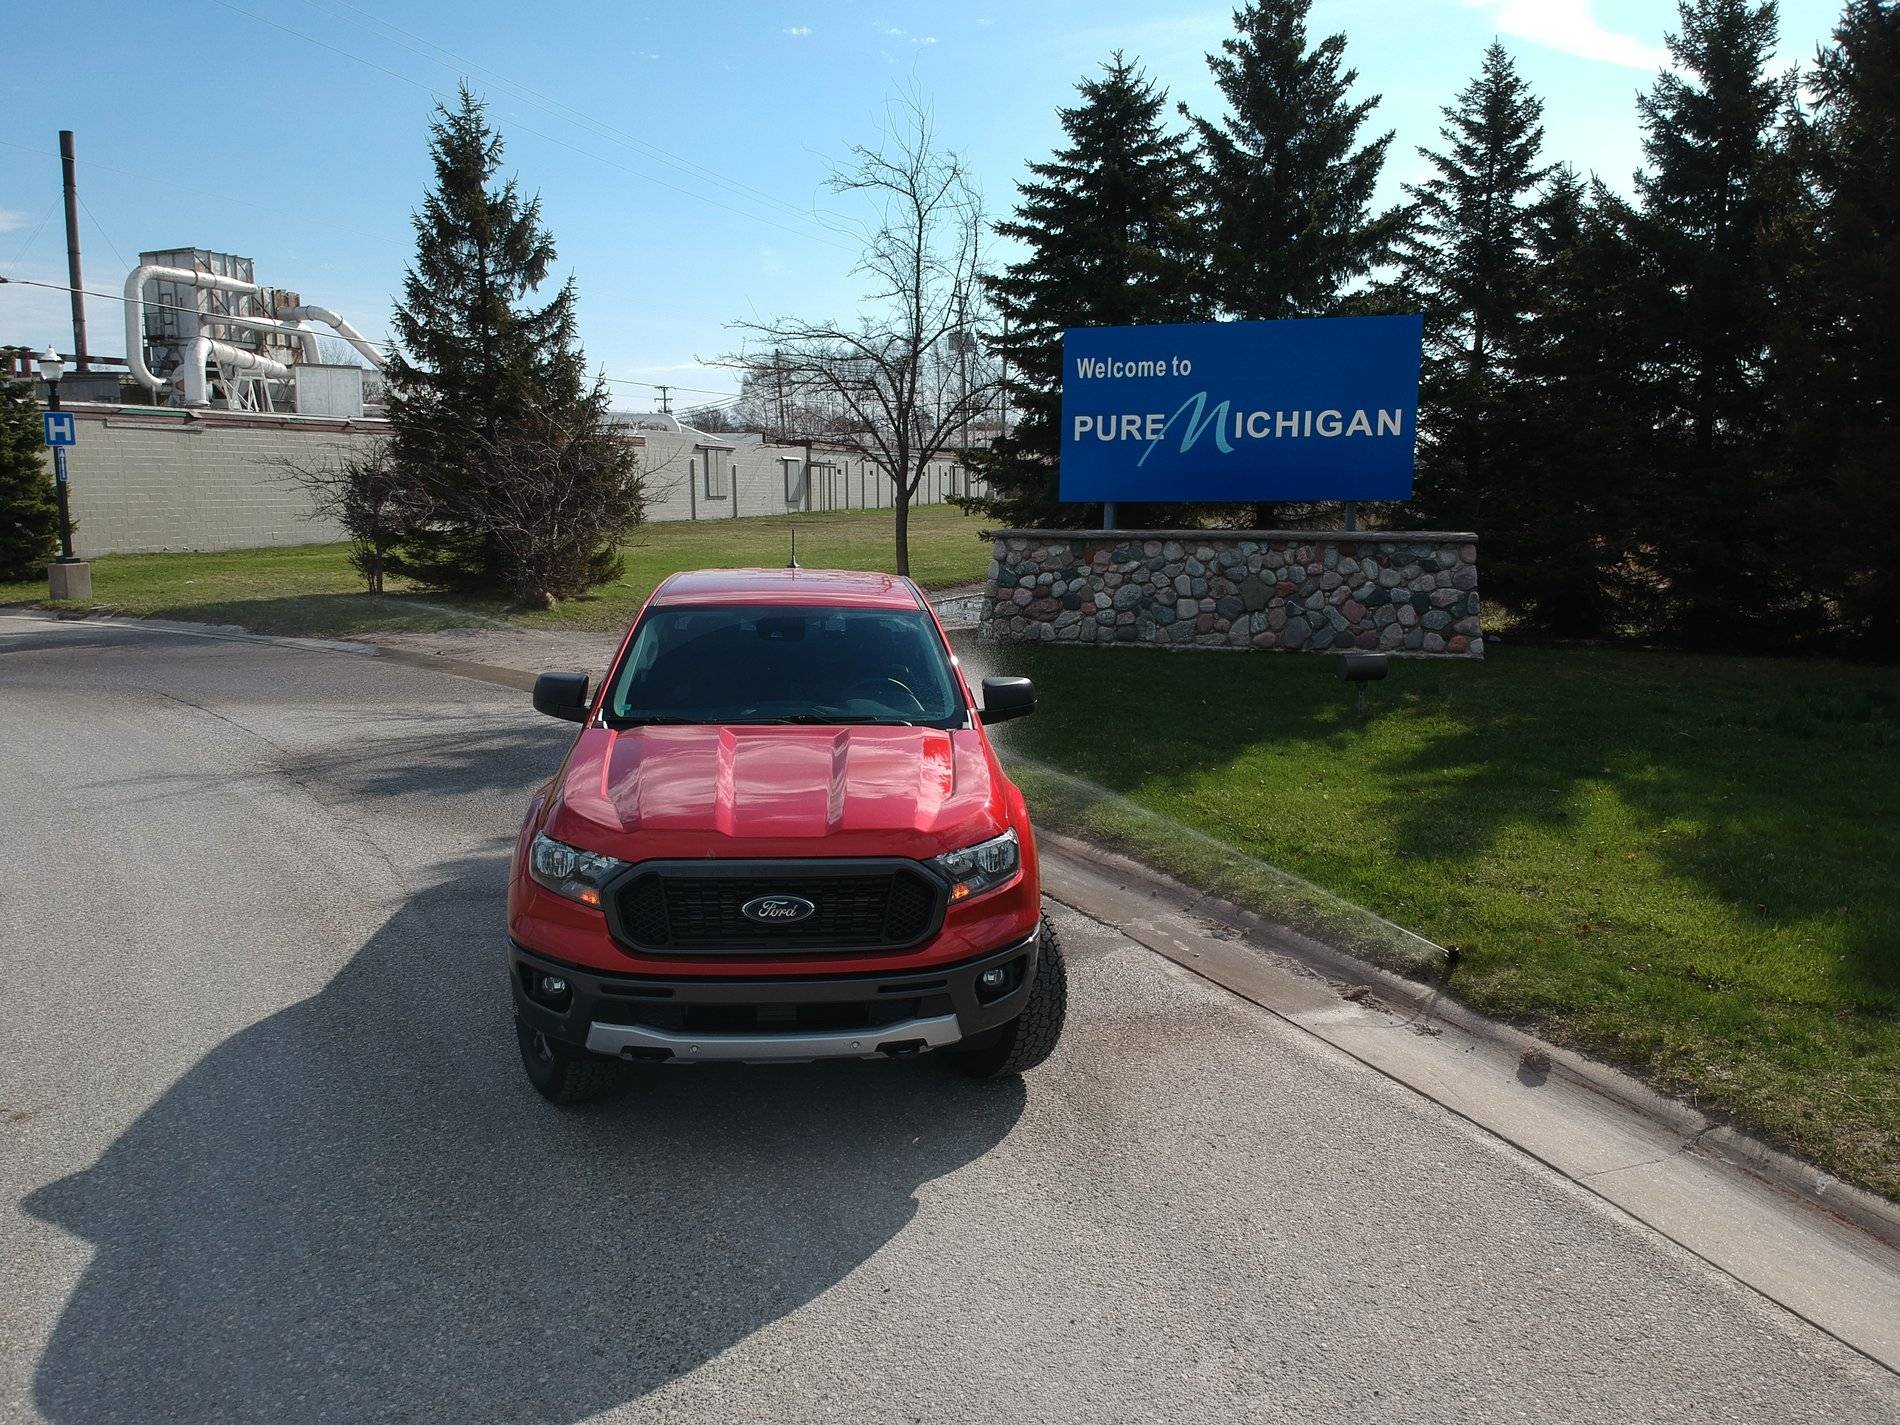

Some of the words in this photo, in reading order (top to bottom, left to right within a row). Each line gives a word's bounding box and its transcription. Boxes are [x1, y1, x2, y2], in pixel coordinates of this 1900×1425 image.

[1076, 356, 1166, 379] Welcome
[1171, 355, 1192, 377] to
[49, 417, 72, 441] H
[1073, 413, 1166, 442] PURE
[1136, 391, 1403, 467] MICHIGAN
[758, 900, 798, 917] Ford
